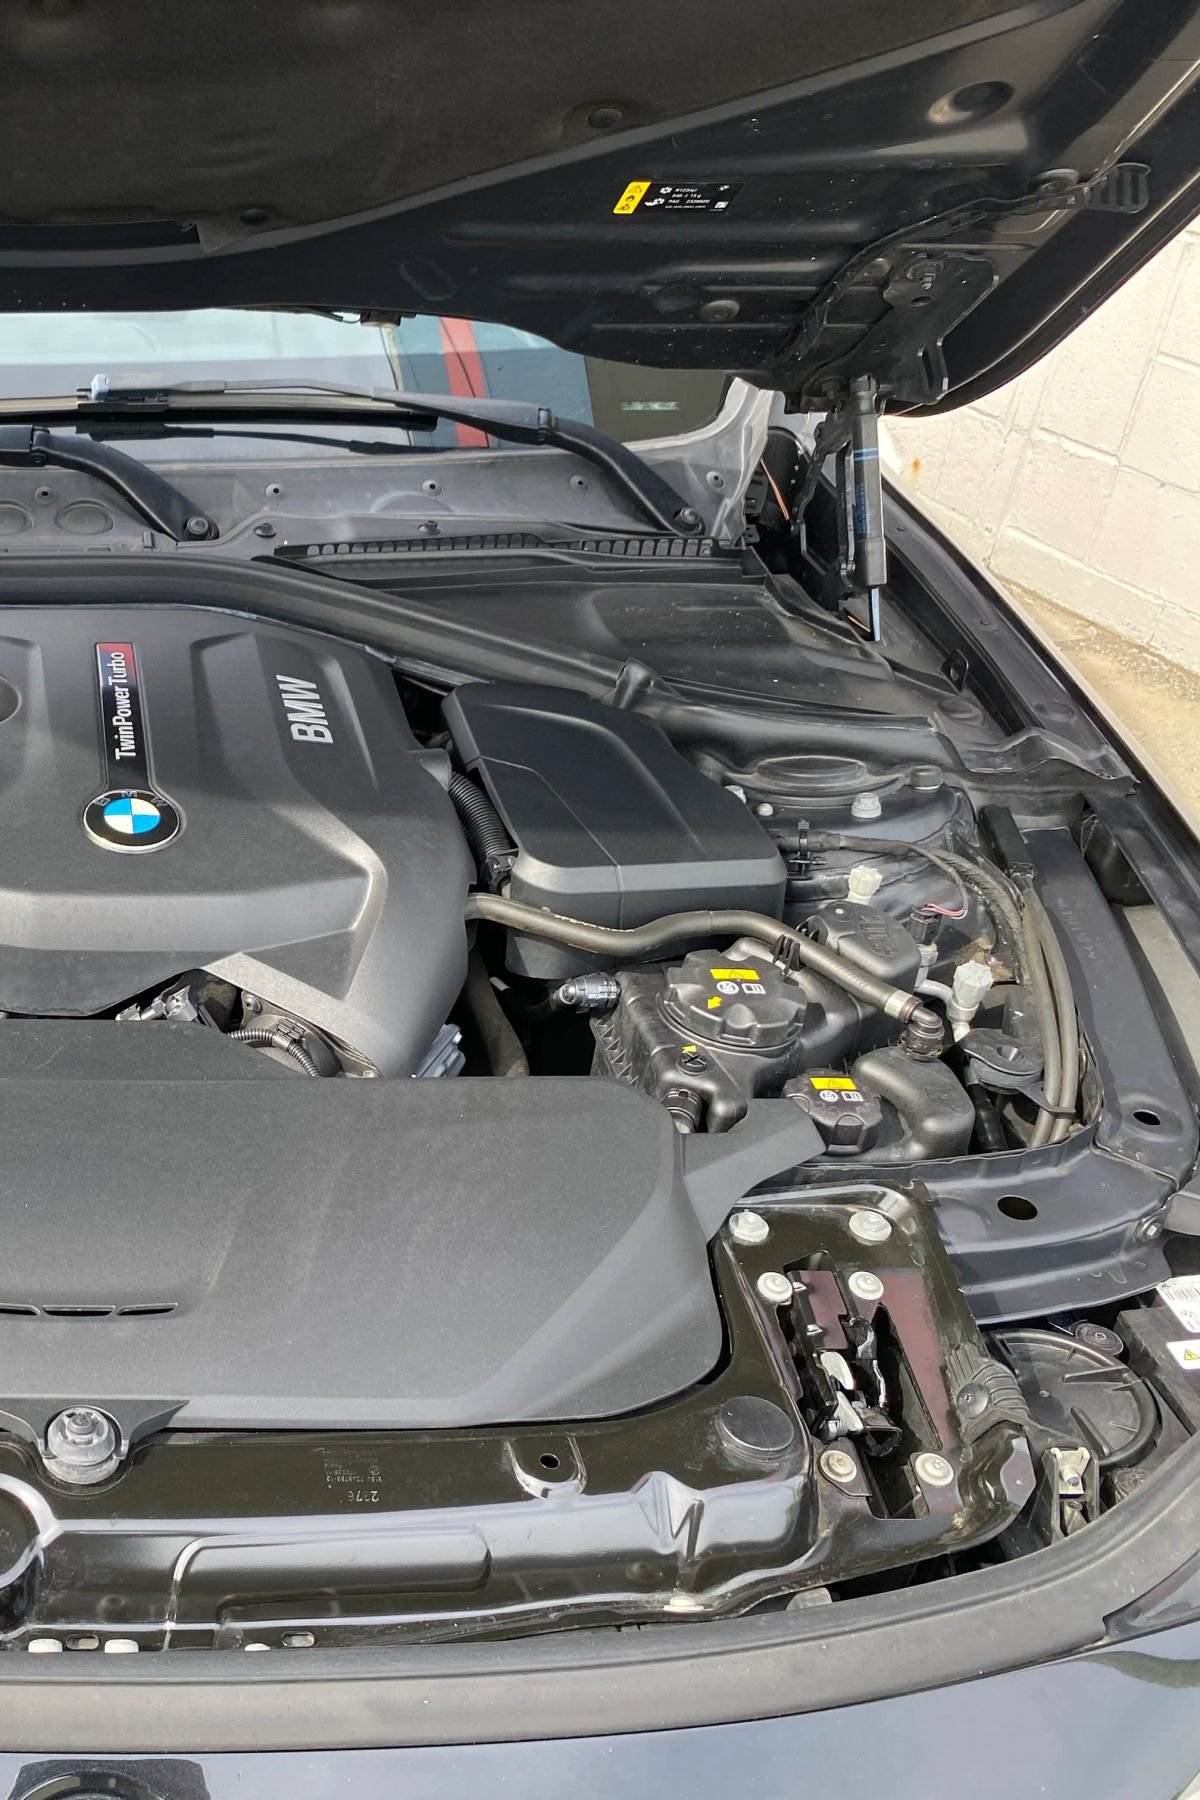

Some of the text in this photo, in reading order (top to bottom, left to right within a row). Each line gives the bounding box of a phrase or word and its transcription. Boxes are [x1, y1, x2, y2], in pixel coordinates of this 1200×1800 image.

[106, 652, 137, 760] TwinPower Turbo
[276, 674, 334, 744] BMW
[94, 790, 168, 807] BMW
